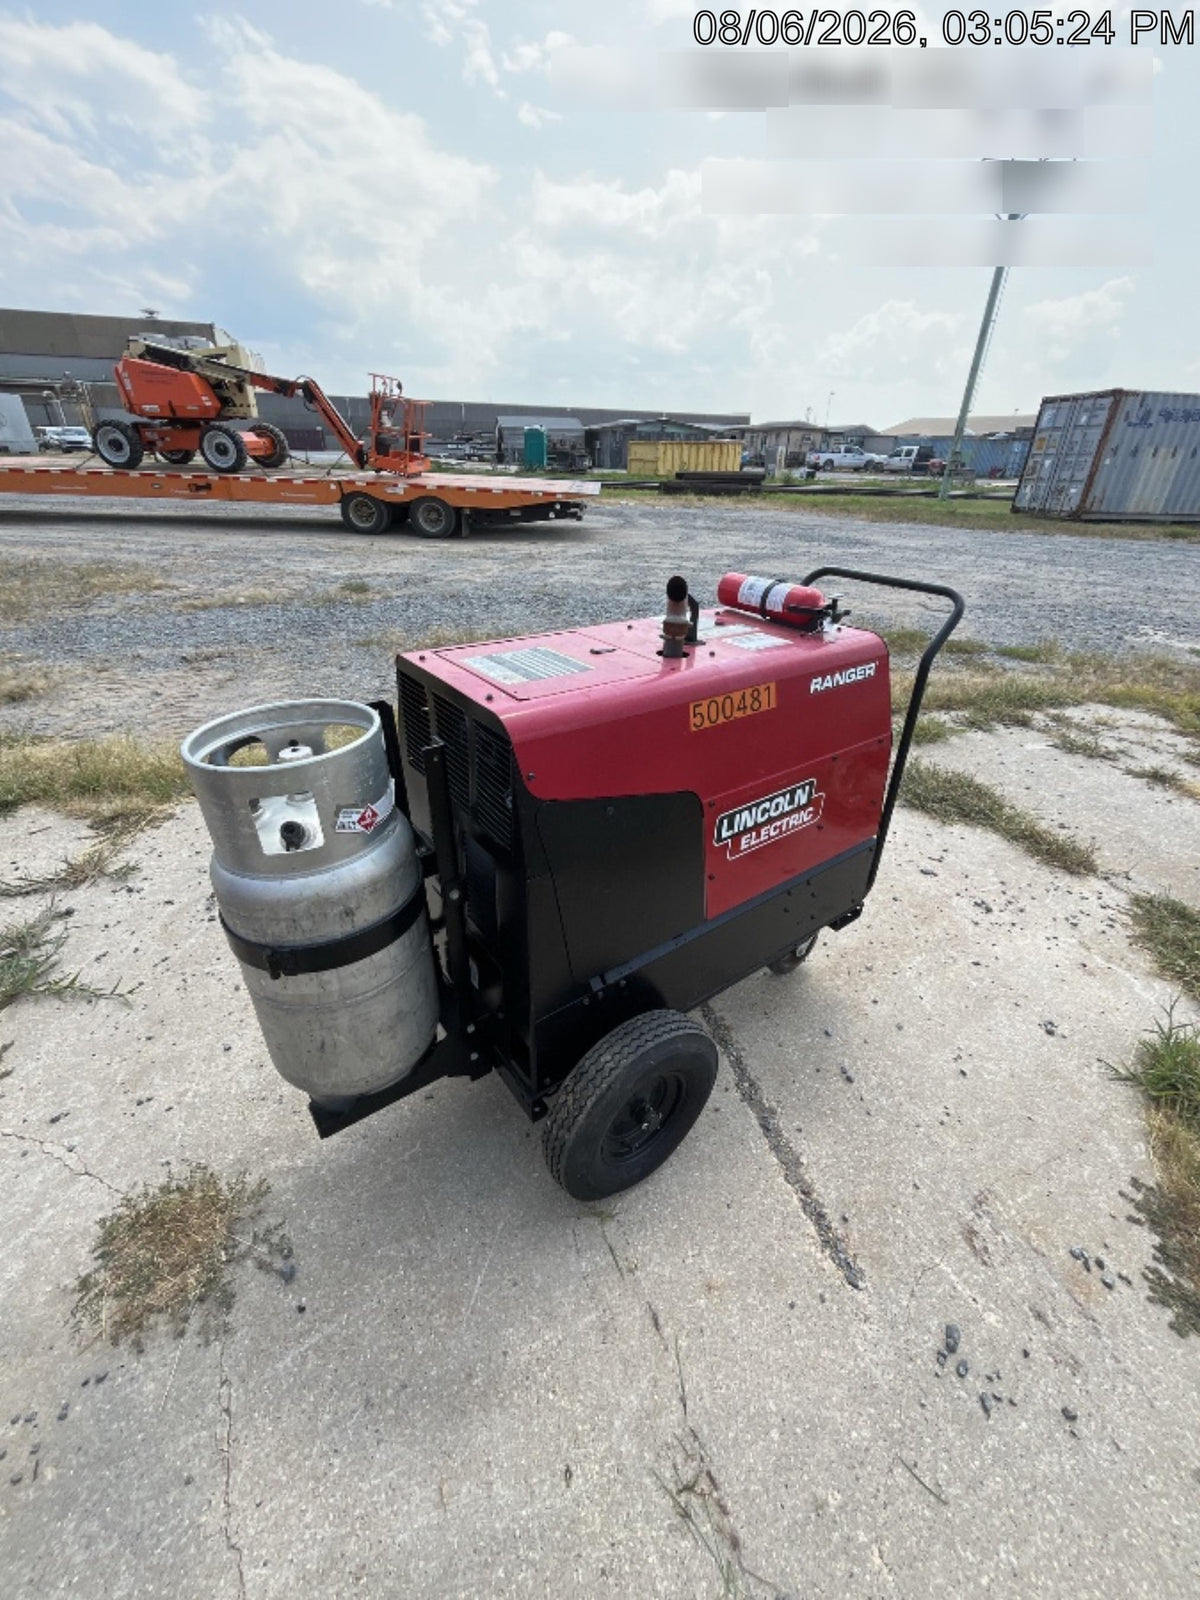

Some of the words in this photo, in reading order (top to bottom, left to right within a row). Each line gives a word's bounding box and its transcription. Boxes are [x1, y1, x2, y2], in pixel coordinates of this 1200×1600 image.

[809, 663, 876, 694] RANGER
[692, 686, 773, 730] 500481
[721, 784, 810, 839] LINCOLN
[740, 807, 813, 851] ELECTRIC
